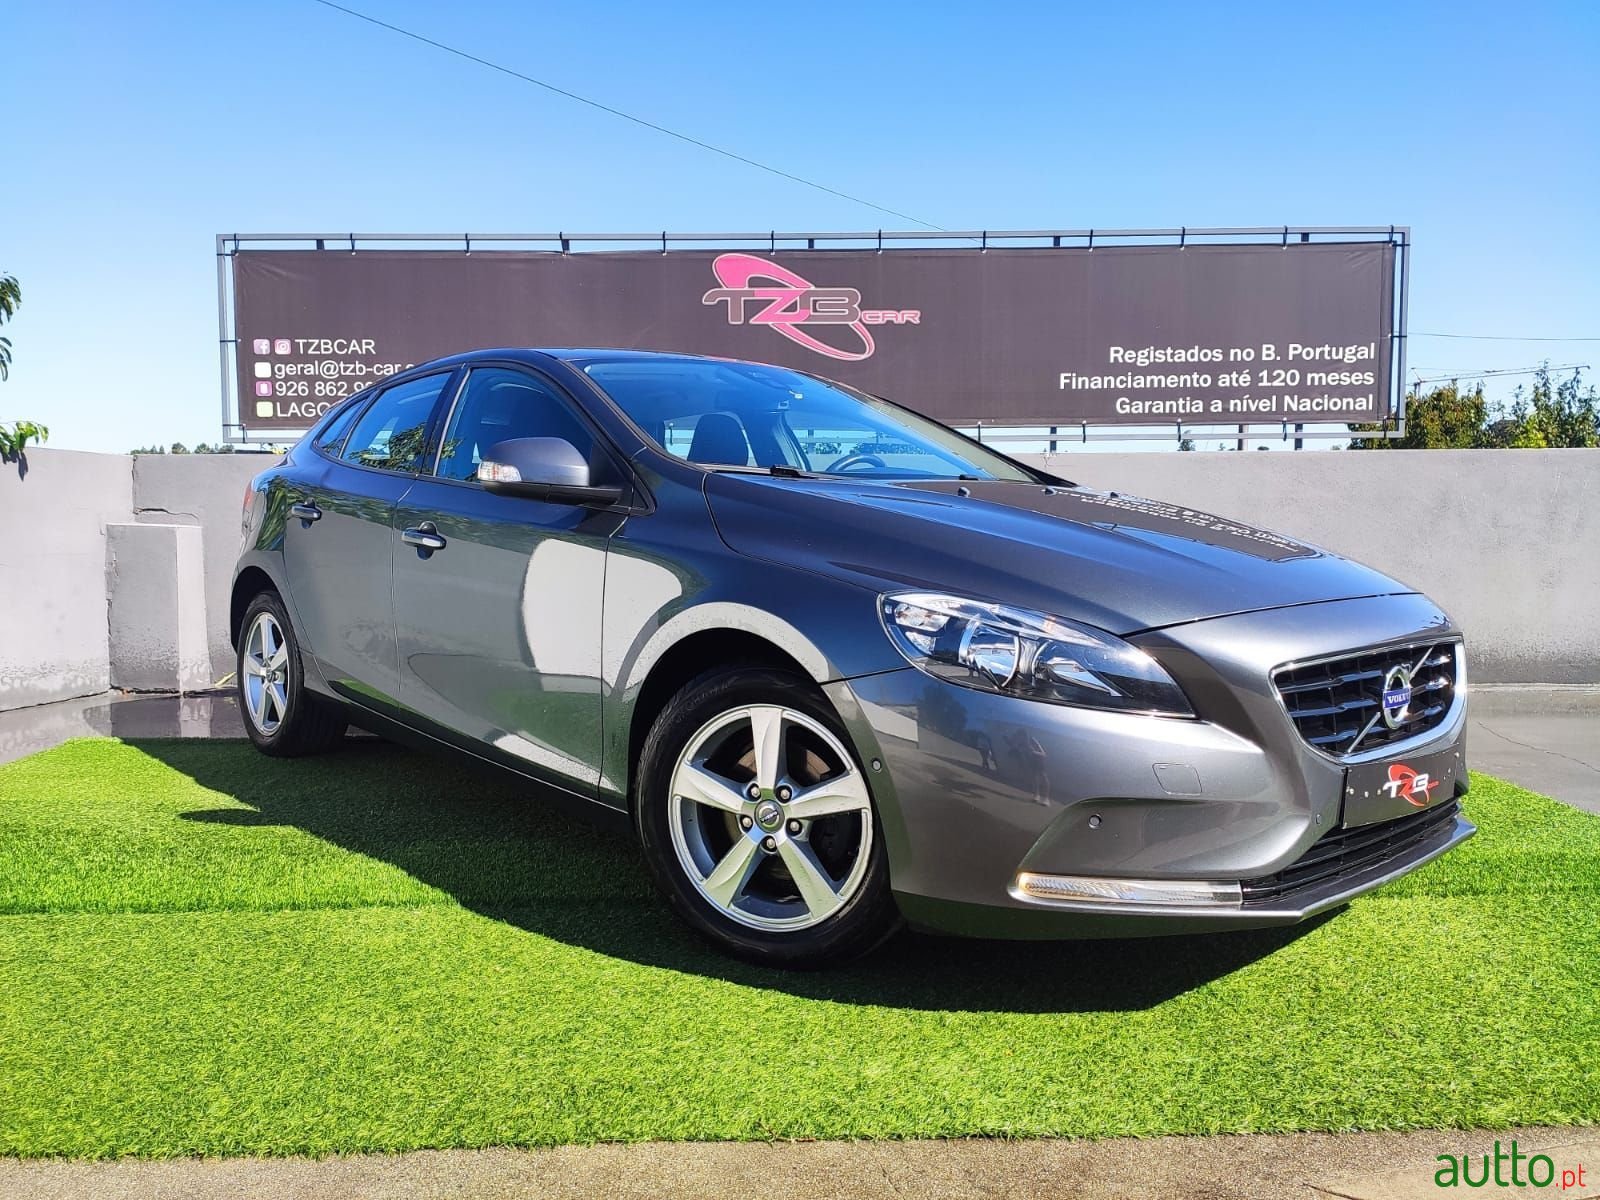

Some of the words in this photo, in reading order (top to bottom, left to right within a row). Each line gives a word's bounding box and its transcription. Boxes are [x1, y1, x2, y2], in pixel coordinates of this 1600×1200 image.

[702, 288, 861, 324] TZB
[861, 310, 921, 324] CAR
[294, 339, 376, 355] TZBCAR
[1109, 346, 1223, 366] Registados
[1229, 348, 1254, 362] no
[1261, 344, 1281, 361] B.
[1288, 343, 1375, 363] Portugal
[275, 381, 309, 397] 926
[314, 381, 348, 397] 862
[1059, 371, 1211, 390] Financiamento
[1217, 369, 1251, 387] até
[1258, 370, 1300, 387] 120
[1306, 370, 1375, 386] meses
[1115, 396, 1204, 414] Garantia
[1210, 398, 1223, 412] a
[1229, 395, 1276, 412] nível
[1283, 394, 1373, 412] Nacional
[1382, 773, 1429, 799] TZB
